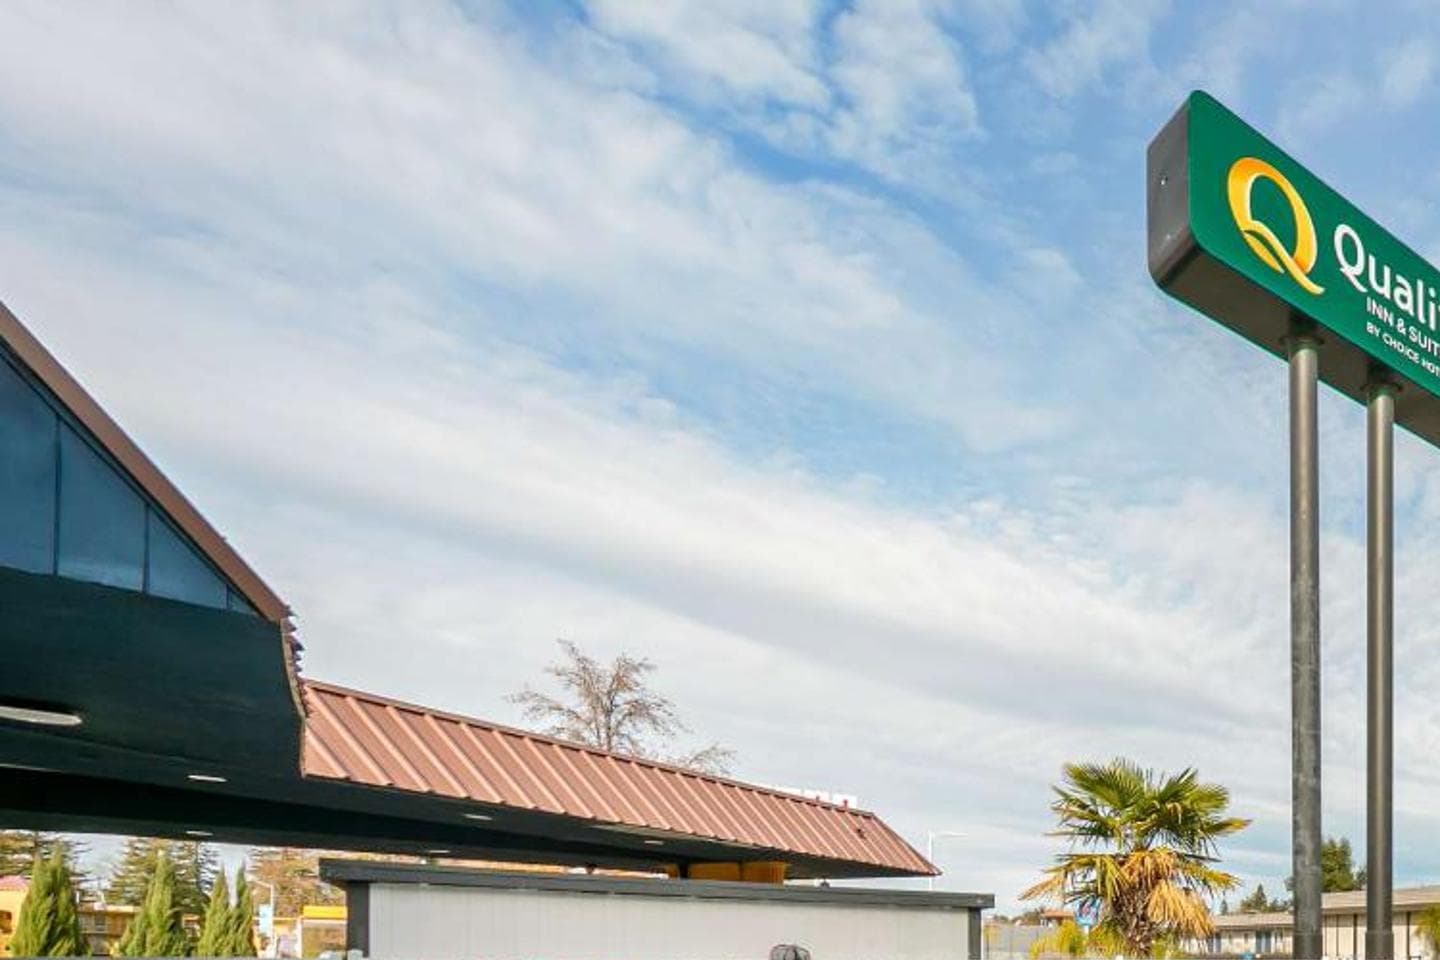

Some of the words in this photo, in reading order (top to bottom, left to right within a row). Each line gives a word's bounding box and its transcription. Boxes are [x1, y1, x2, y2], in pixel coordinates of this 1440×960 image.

[1367, 297, 1394, 326] INN
[1397, 318, 1406, 336] &
[1366, 322, 1380, 336] BY
[1382, 333, 1419, 363] CHOICE
